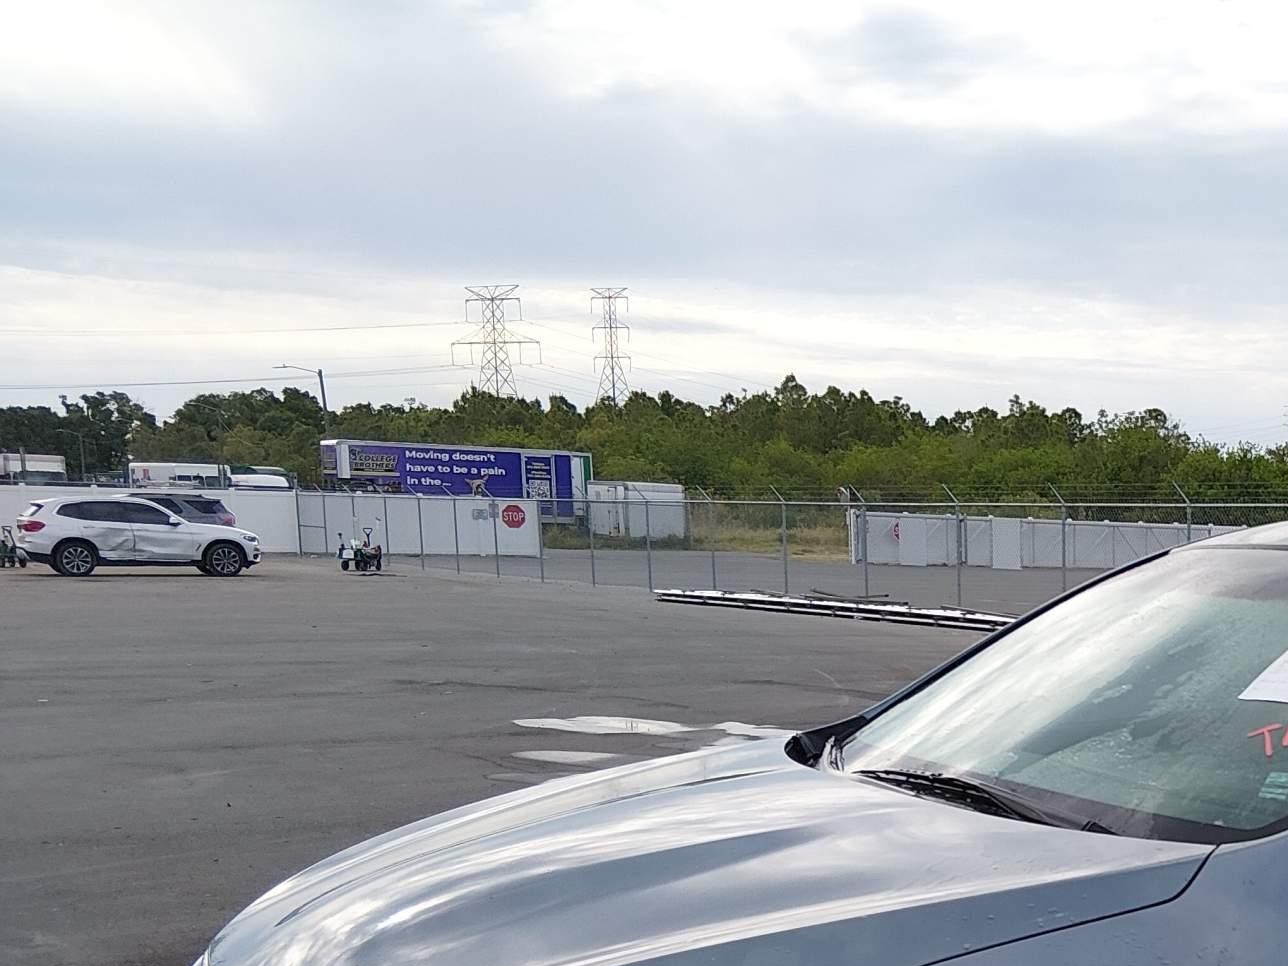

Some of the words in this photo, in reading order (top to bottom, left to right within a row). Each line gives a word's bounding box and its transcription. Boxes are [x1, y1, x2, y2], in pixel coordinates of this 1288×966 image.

[358, 454, 397, 462] COLLEGE
[405, 450, 450, 461] Moving
[452, 452, 496, 462] doesn't
[354, 461, 396, 469] BROTHERS
[406, 463, 435, 472] have
[437, 465, 451, 473] to
[453, 465, 468, 474] be
[480, 467, 506, 476] pain
[407, 476, 418, 485] in
[503, 512, 525, 521] STOP
